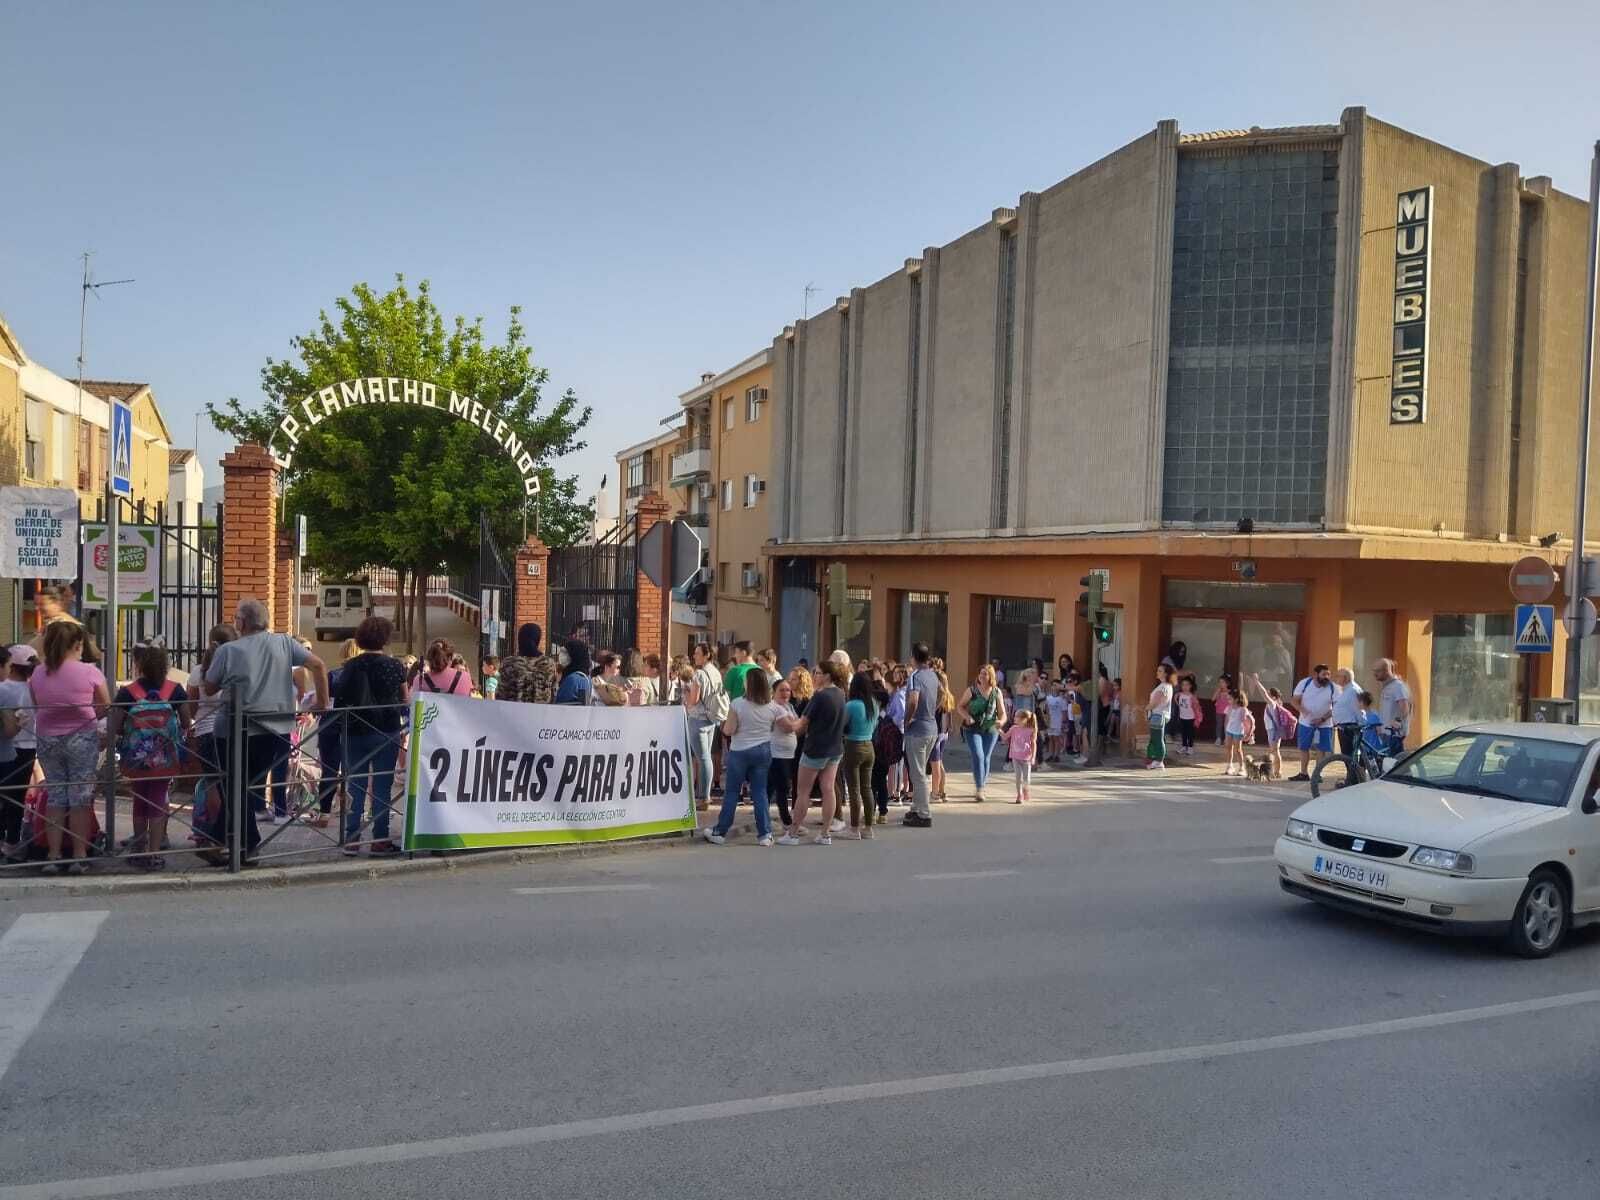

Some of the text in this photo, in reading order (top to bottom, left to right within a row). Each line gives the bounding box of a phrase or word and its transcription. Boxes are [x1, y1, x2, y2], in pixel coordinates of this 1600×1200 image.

[1391, 191, 1425, 421] MUEBLES
[301, 376, 436, 426] CAMACHO
[448, 390, 541, 496] MELENDO
[25, 508, 52, 518] NO AL
[15, 517, 63, 529] CIERRE DE
[15, 527, 62, 538] UNIDADES
[25, 538, 52, 547] EN LA
[18, 547, 59, 557] ESCUELA
[538, 728, 621, 741] CEIP CAMACHO MELENDO
[429, 735, 683, 803] 2 LÍNEAS PARA 3 AÑOS
[497, 811, 511, 823] POR
[511, 811, 519, 823] EL
[520, 810, 551, 823] DERECHO
[556, 810, 565, 821] LA
[596, 809, 605, 820] DE
[1369, 872, 1385, 887] VH
